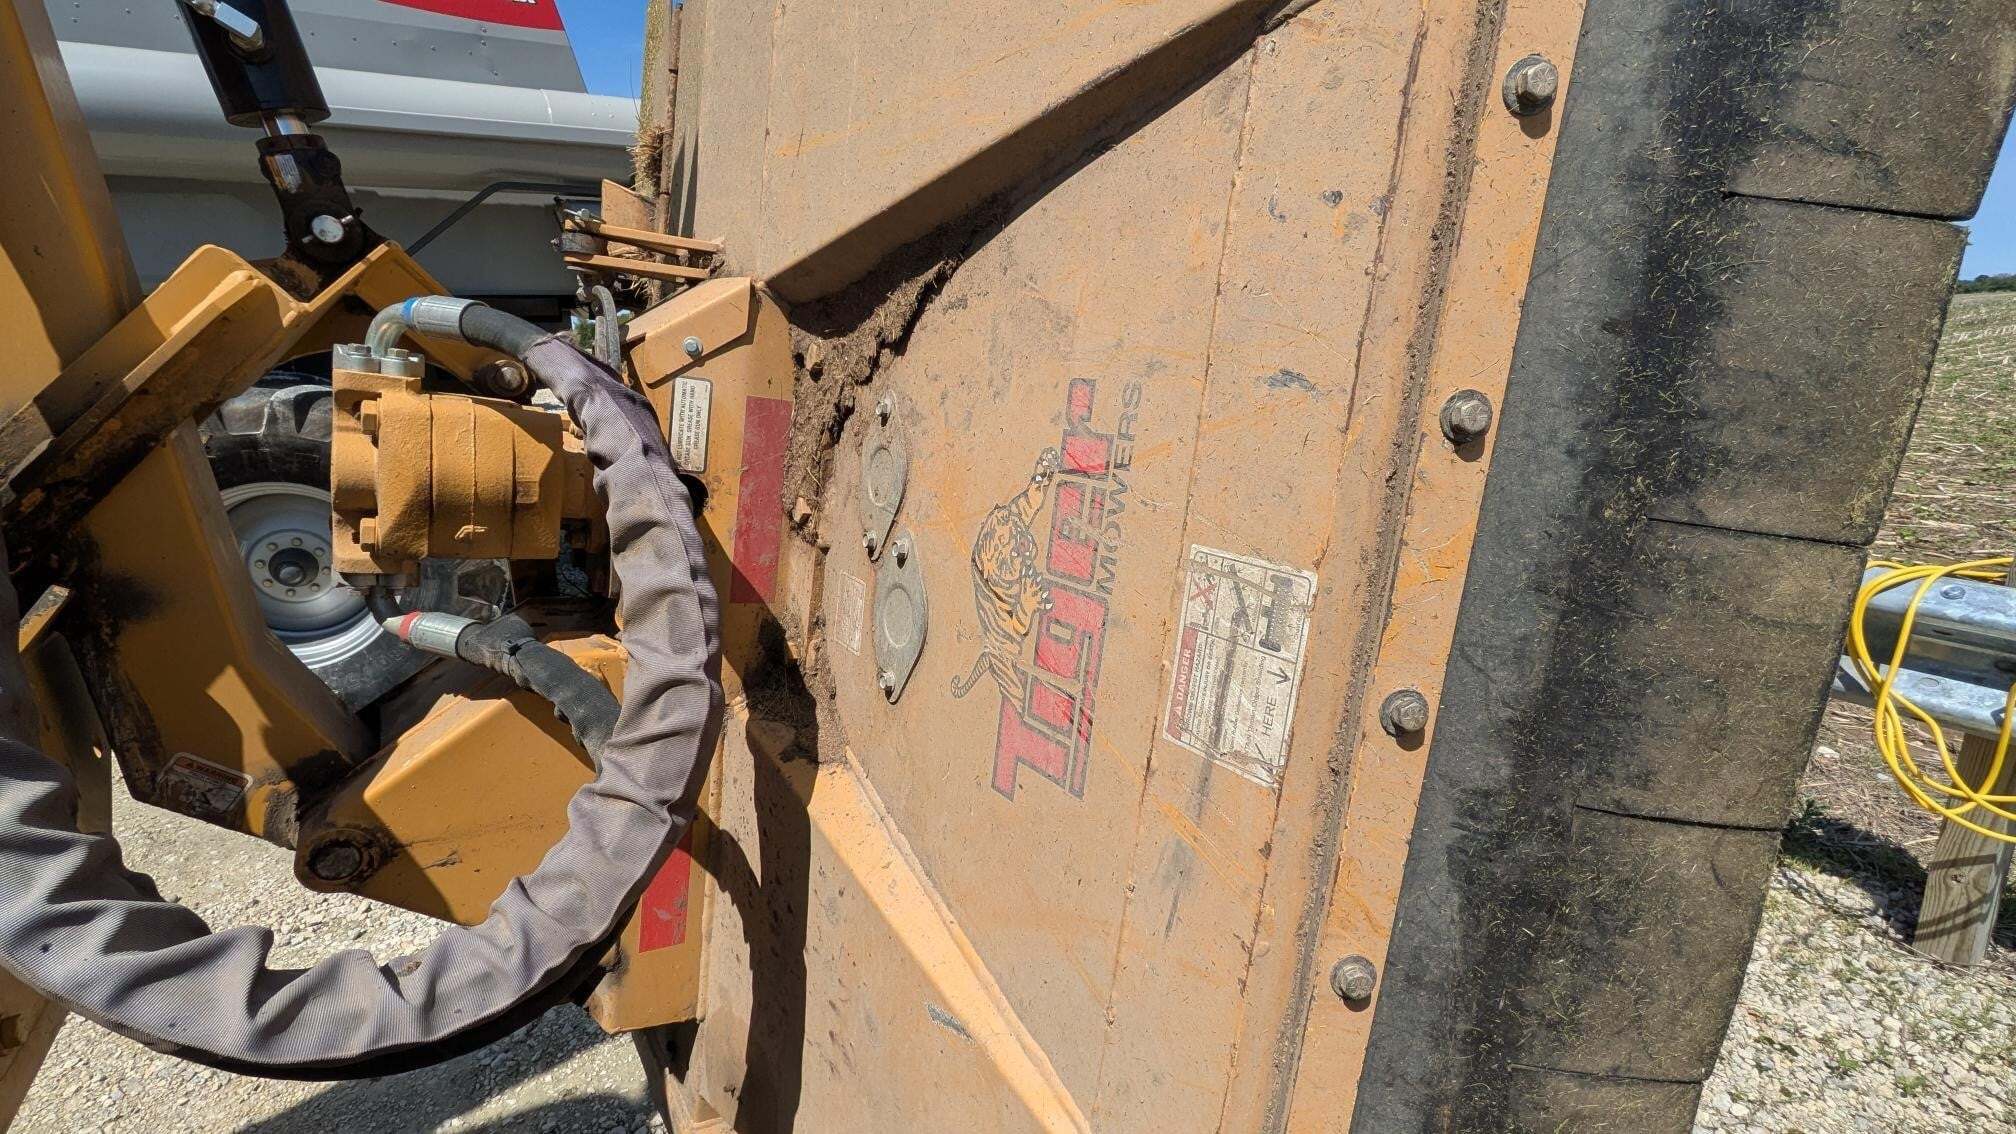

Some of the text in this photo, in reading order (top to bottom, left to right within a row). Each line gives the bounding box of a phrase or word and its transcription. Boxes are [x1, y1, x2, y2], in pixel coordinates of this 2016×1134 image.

[1096, 380, 1142, 596] MOWERS
[991, 378, 1114, 801] Tiger
[1177, 648, 1192, 701] DANGER
[1260, 694, 1277, 737] HERE
